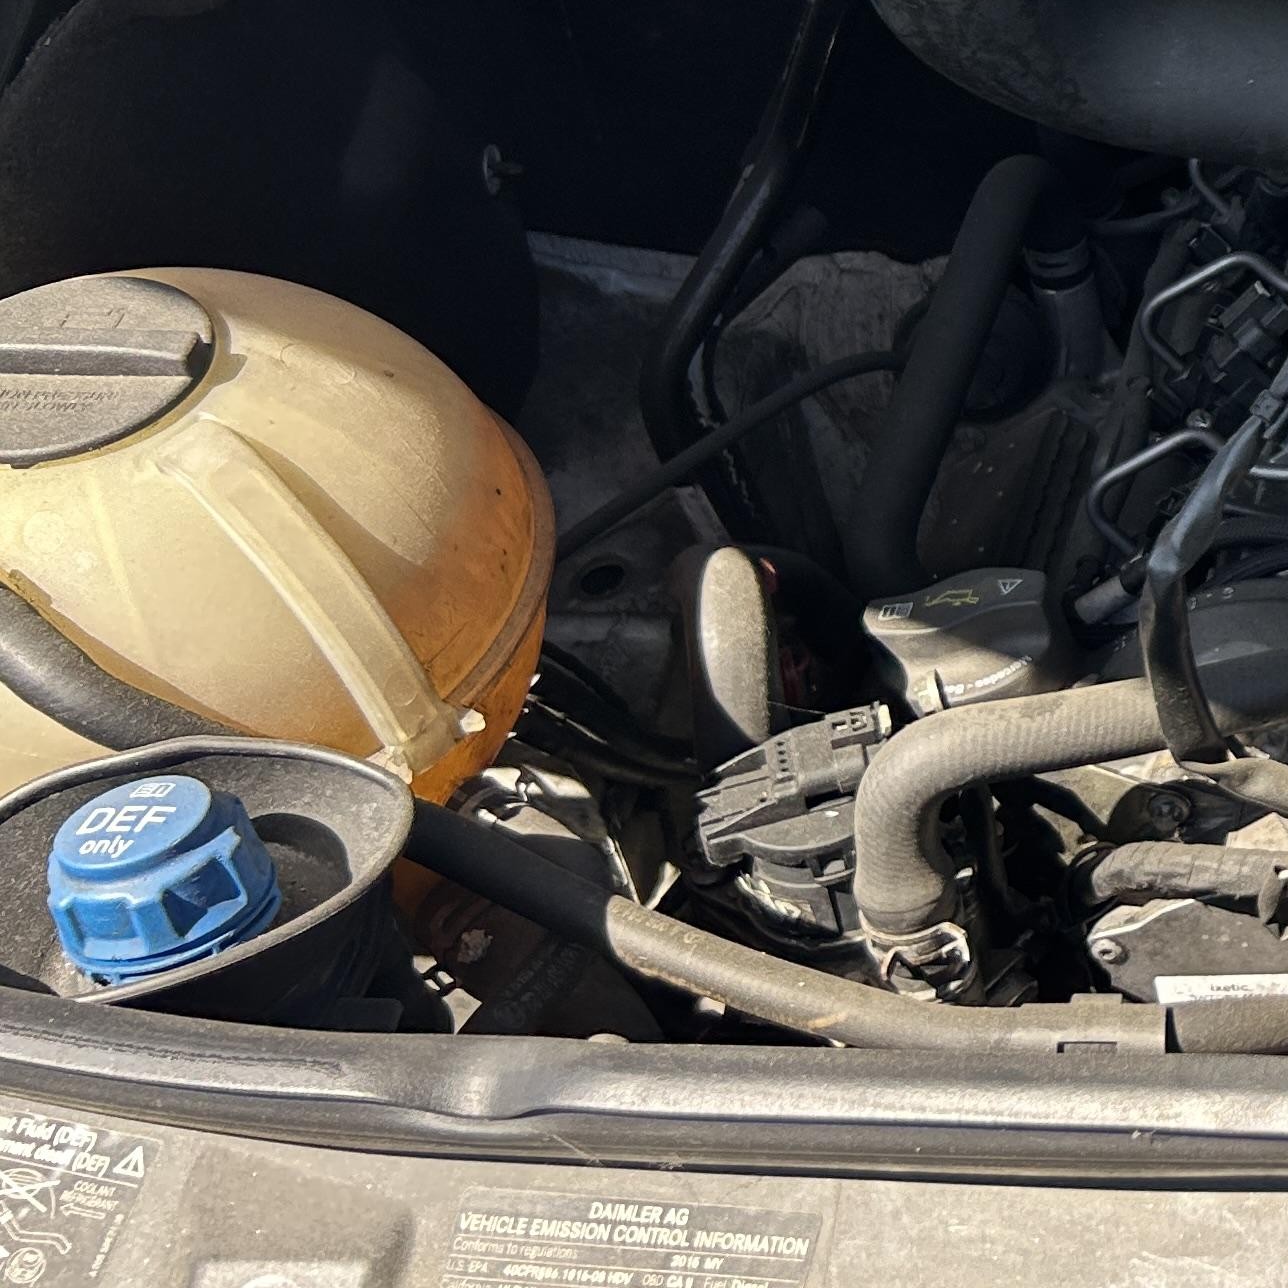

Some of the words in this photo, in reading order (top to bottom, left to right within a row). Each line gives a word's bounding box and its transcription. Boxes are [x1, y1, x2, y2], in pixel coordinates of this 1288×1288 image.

[76, 805, 176, 836] DEF
[79, 834, 135, 859] only
[16, 1117, 57, 1141] Fluid
[71, 1151, 111, 1178] (DEF)
[73, 1179, 117, 1197] COOLANT
[588, 1201, 662, 1225] DAIMLER
[663, 1208, 690, 1226] AG
[459, 1212, 529, 1235] VEHICLE
[529, 1218, 612, 1241] EMISSION
[613, 1223, 690, 1247] CONTROL
[693, 1229, 810, 1255] INFORMATION
[453, 1236, 504, 1253] Conforms
[519, 1245, 578, 1259] regulations
[467, 1261, 489, 1273] EPA
